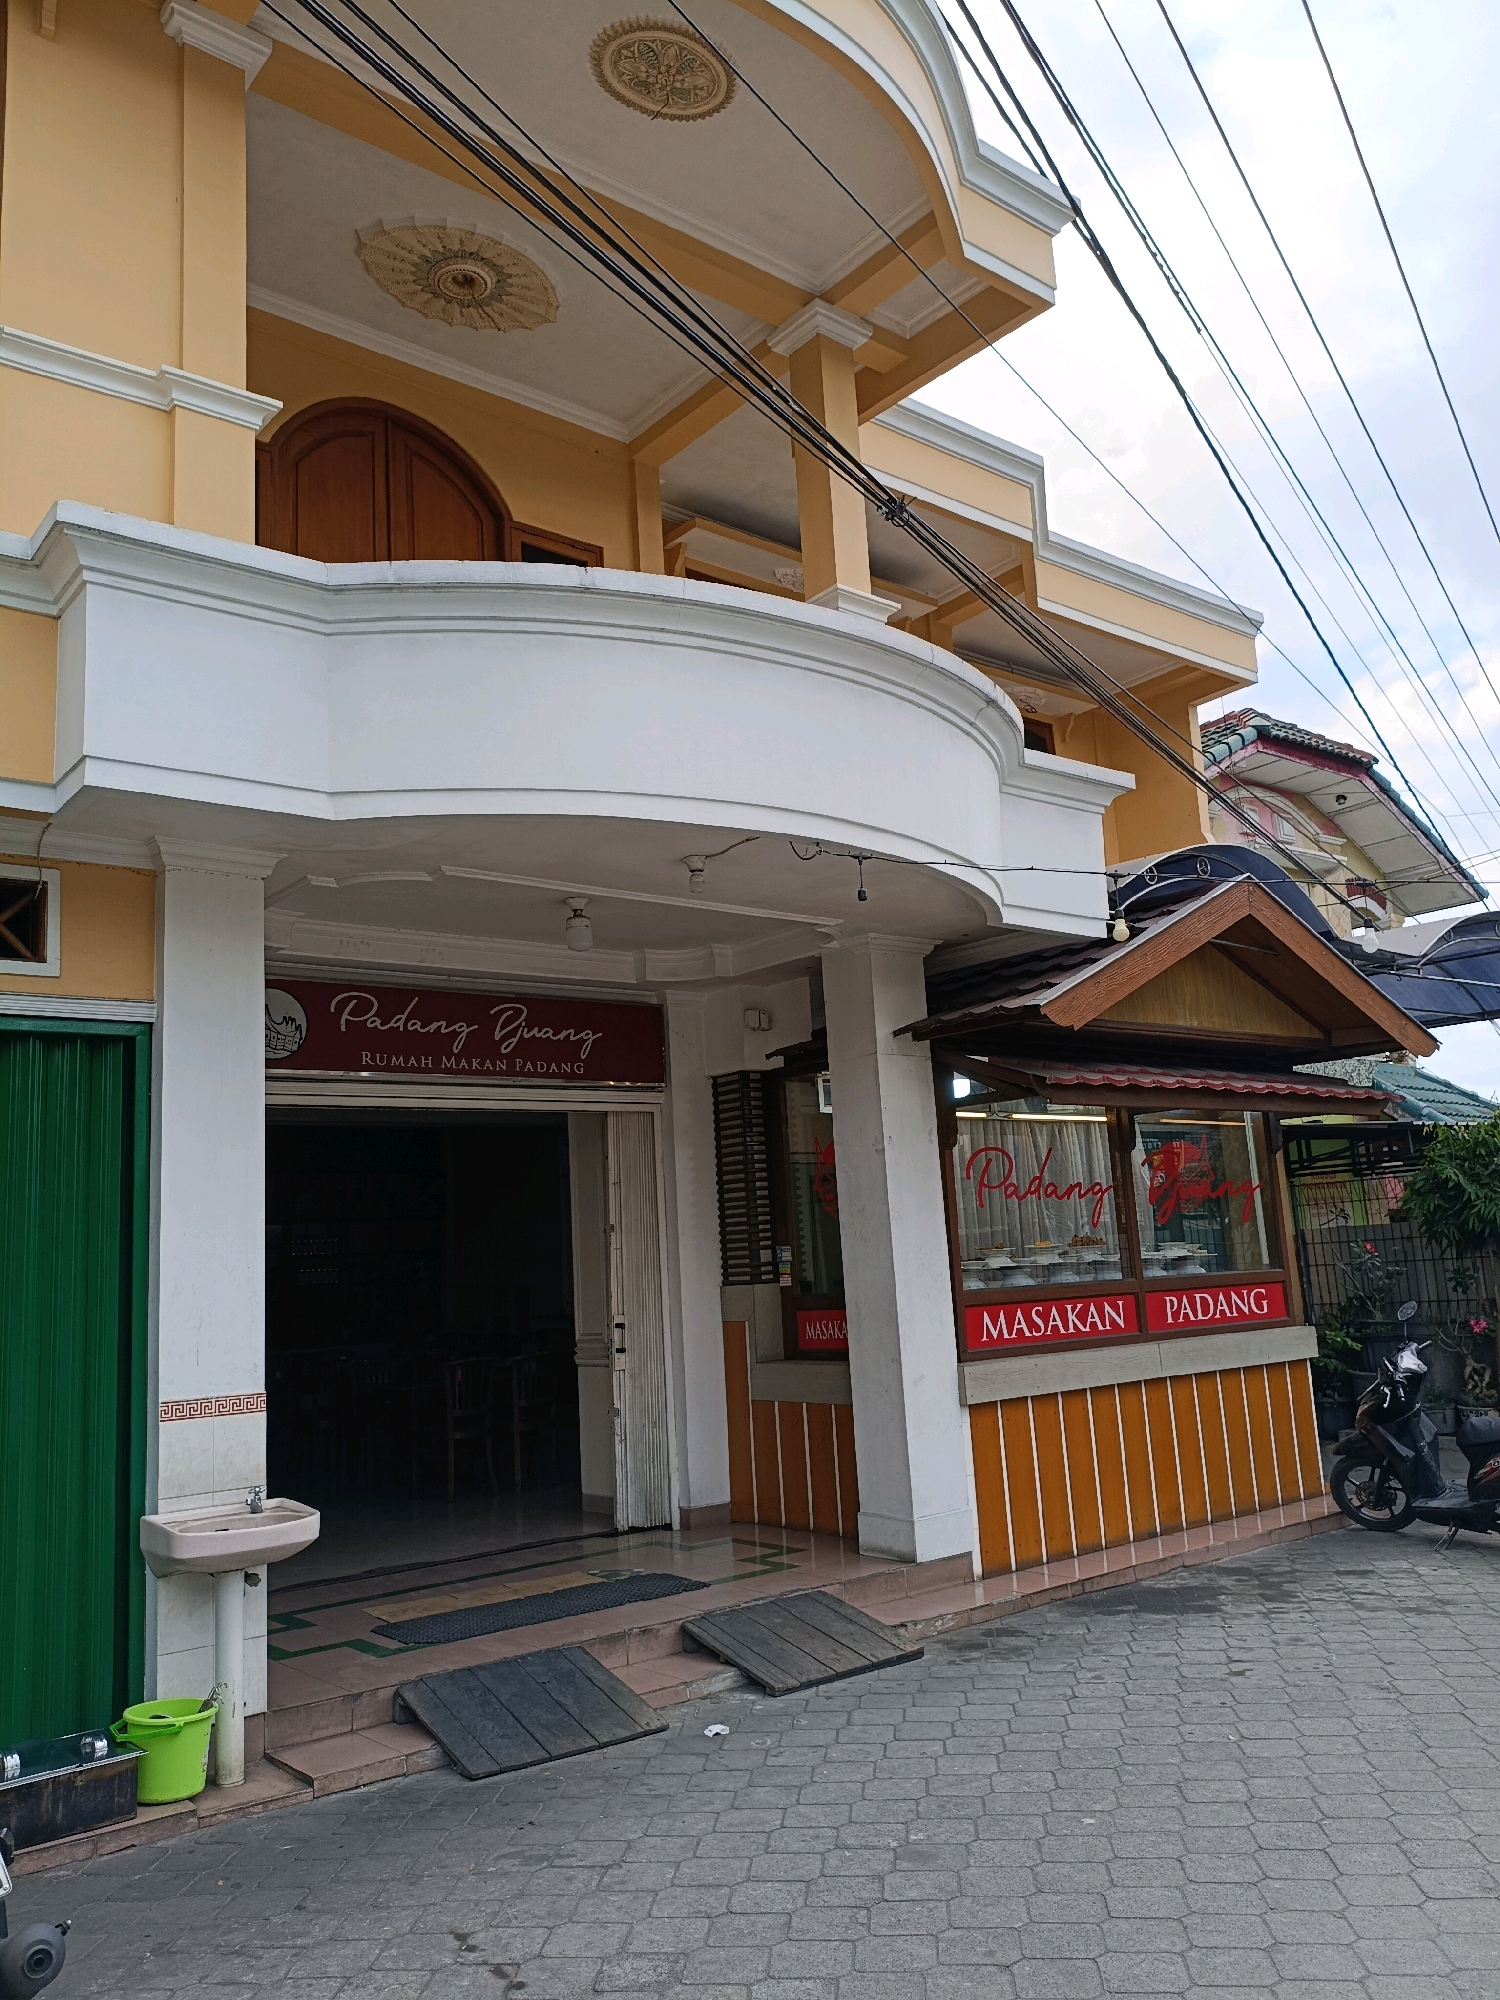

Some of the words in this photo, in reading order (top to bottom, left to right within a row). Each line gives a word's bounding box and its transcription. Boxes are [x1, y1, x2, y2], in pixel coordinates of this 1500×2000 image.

[330, 991, 479, 1054] Padang
[361, 1051, 433, 1068] RUMAH
[440, 1055, 507, 1071] MAKAN
[515, 1058, 585, 1074] PADANG
[965, 1146, 1114, 1228] Padang
[805, 1320, 849, 1340] MASAKA
[980, 1300, 1126, 1343] MASAKAN
[1163, 1288, 1270, 1324] PADANG
